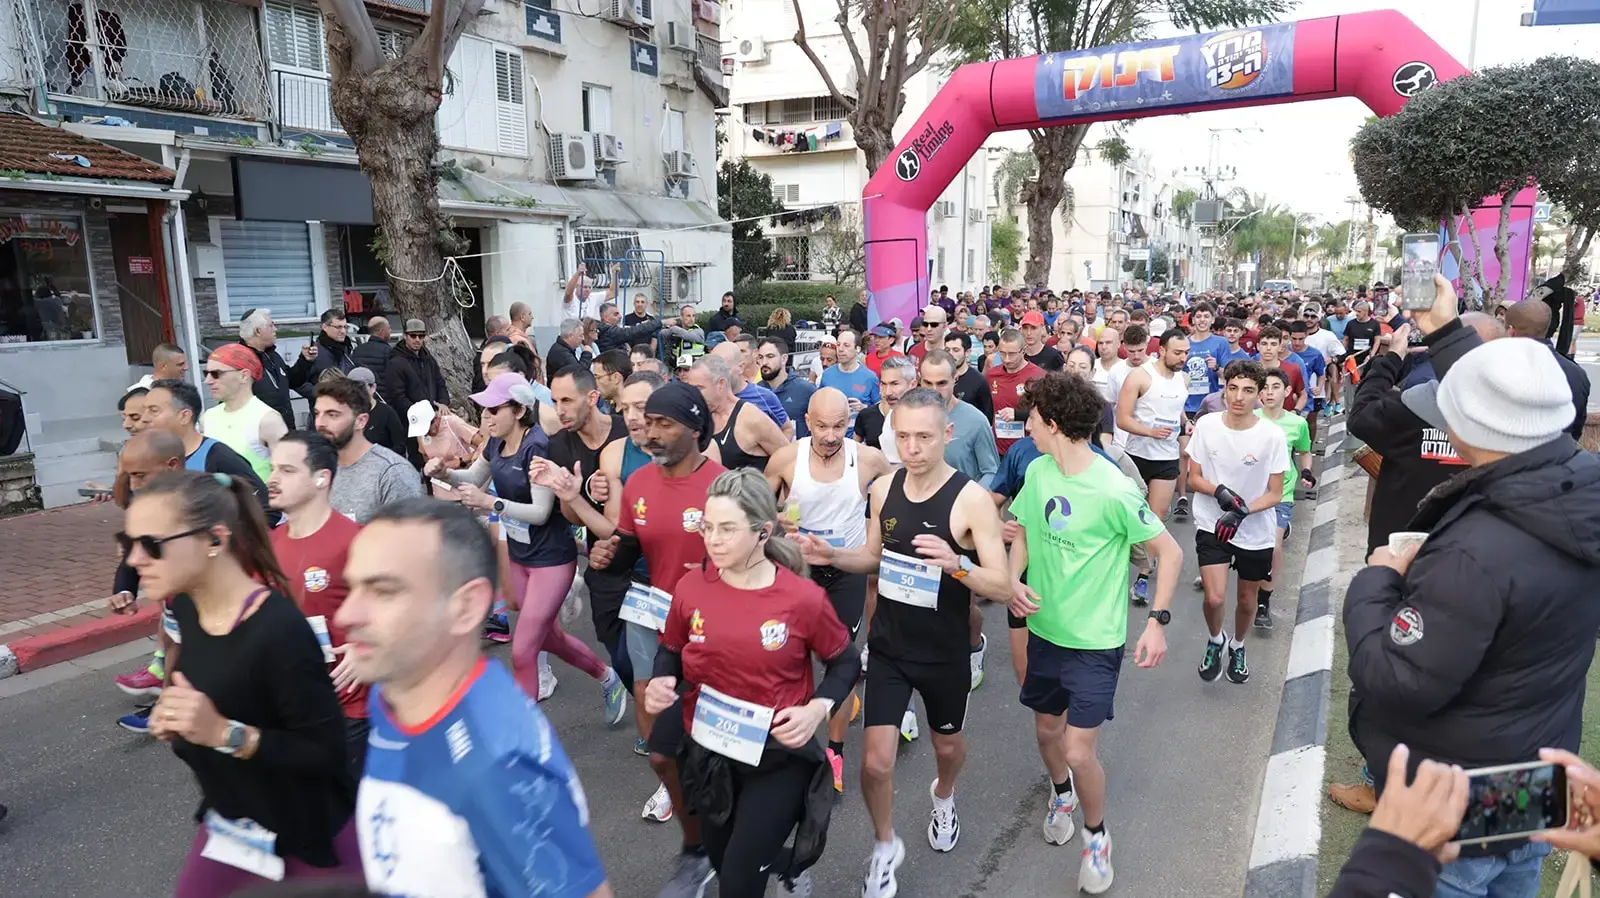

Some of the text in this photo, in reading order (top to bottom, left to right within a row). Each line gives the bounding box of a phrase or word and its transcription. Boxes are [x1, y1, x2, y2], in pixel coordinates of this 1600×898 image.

[1200, 30, 1262, 68] מרוץ
[1217, 49, 1243, 66] יהודה
[912, 121, 934, 153] Real
[919, 120, 954, 160] Timing
[901, 574, 915, 586] 50
[636, 599, 648, 610] 90
[715, 716, 740, 736] 204
